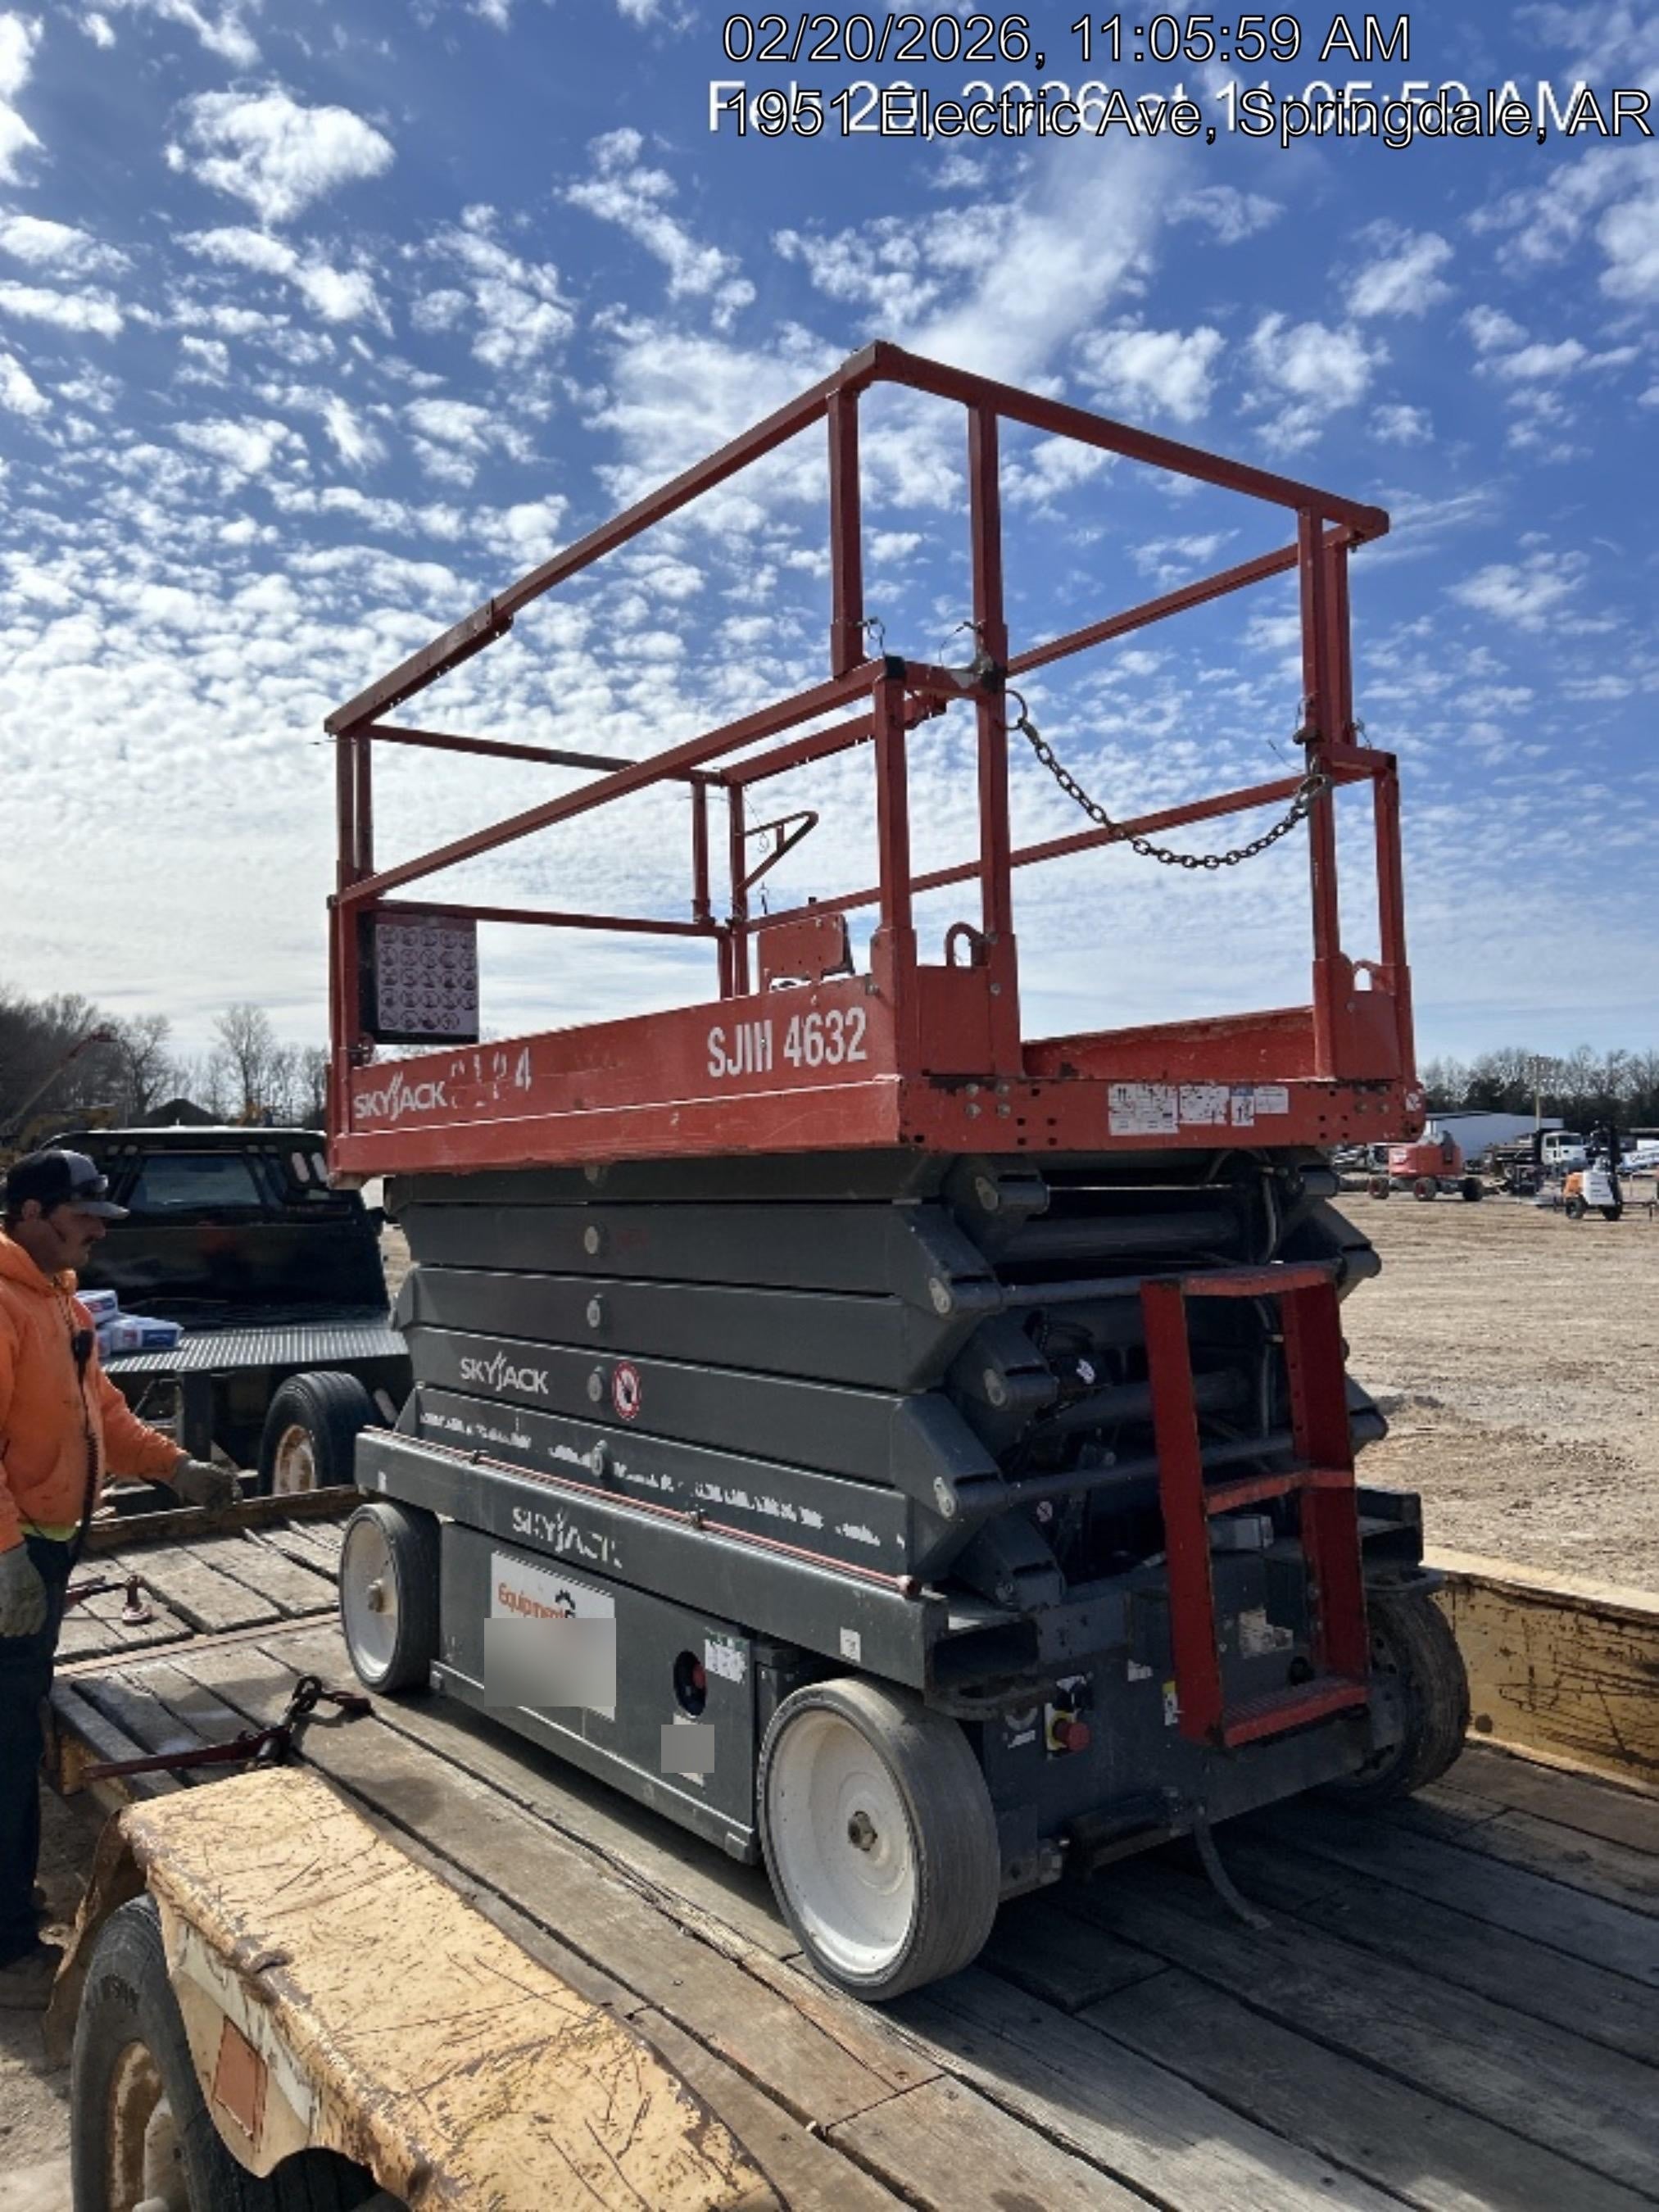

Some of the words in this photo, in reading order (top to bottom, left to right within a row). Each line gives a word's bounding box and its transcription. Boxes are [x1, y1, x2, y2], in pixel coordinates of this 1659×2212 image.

[783, 1006, 868, 1068] 4632
[353, 1070, 447, 1122] SKYJACK
[460, 1350, 549, 1394] SKYJACK
